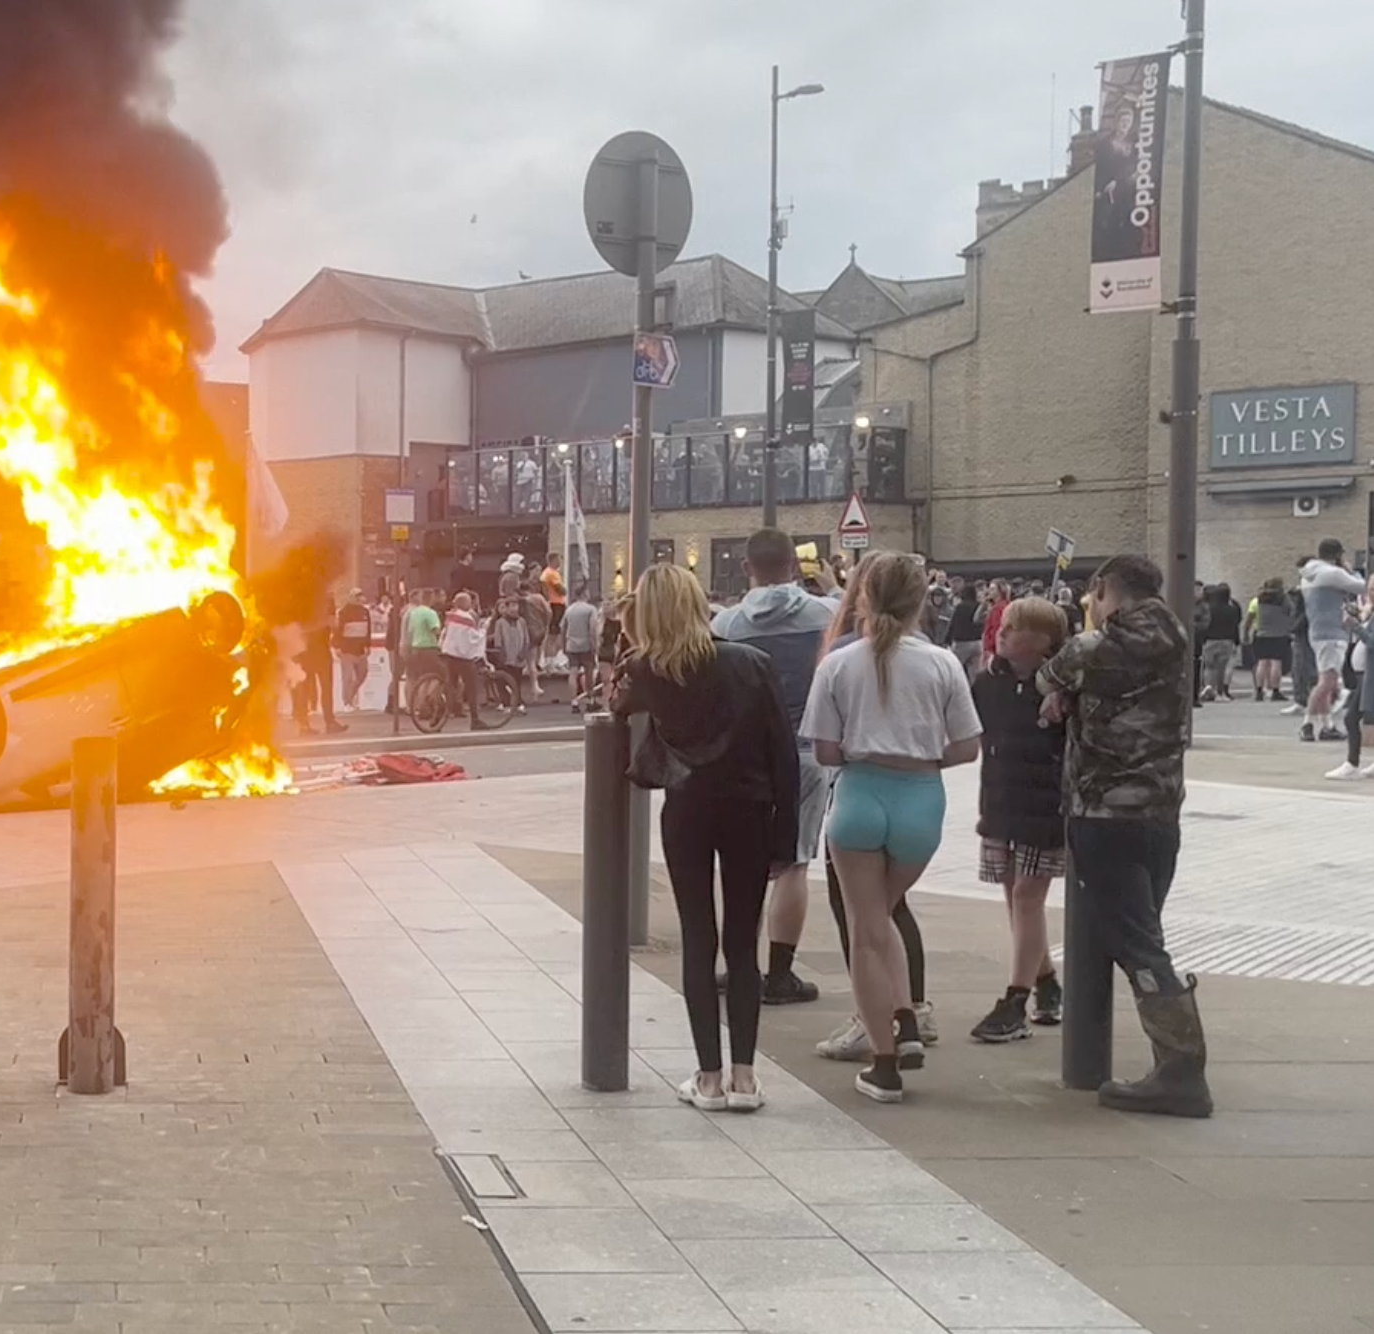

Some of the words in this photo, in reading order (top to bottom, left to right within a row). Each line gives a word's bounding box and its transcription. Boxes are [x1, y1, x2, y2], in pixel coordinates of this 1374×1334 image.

[1130, 62, 1159, 227] Opportunites
[1230, 396, 1330, 423] VESTA
[1216, 427, 1346, 456] TILLEYS
